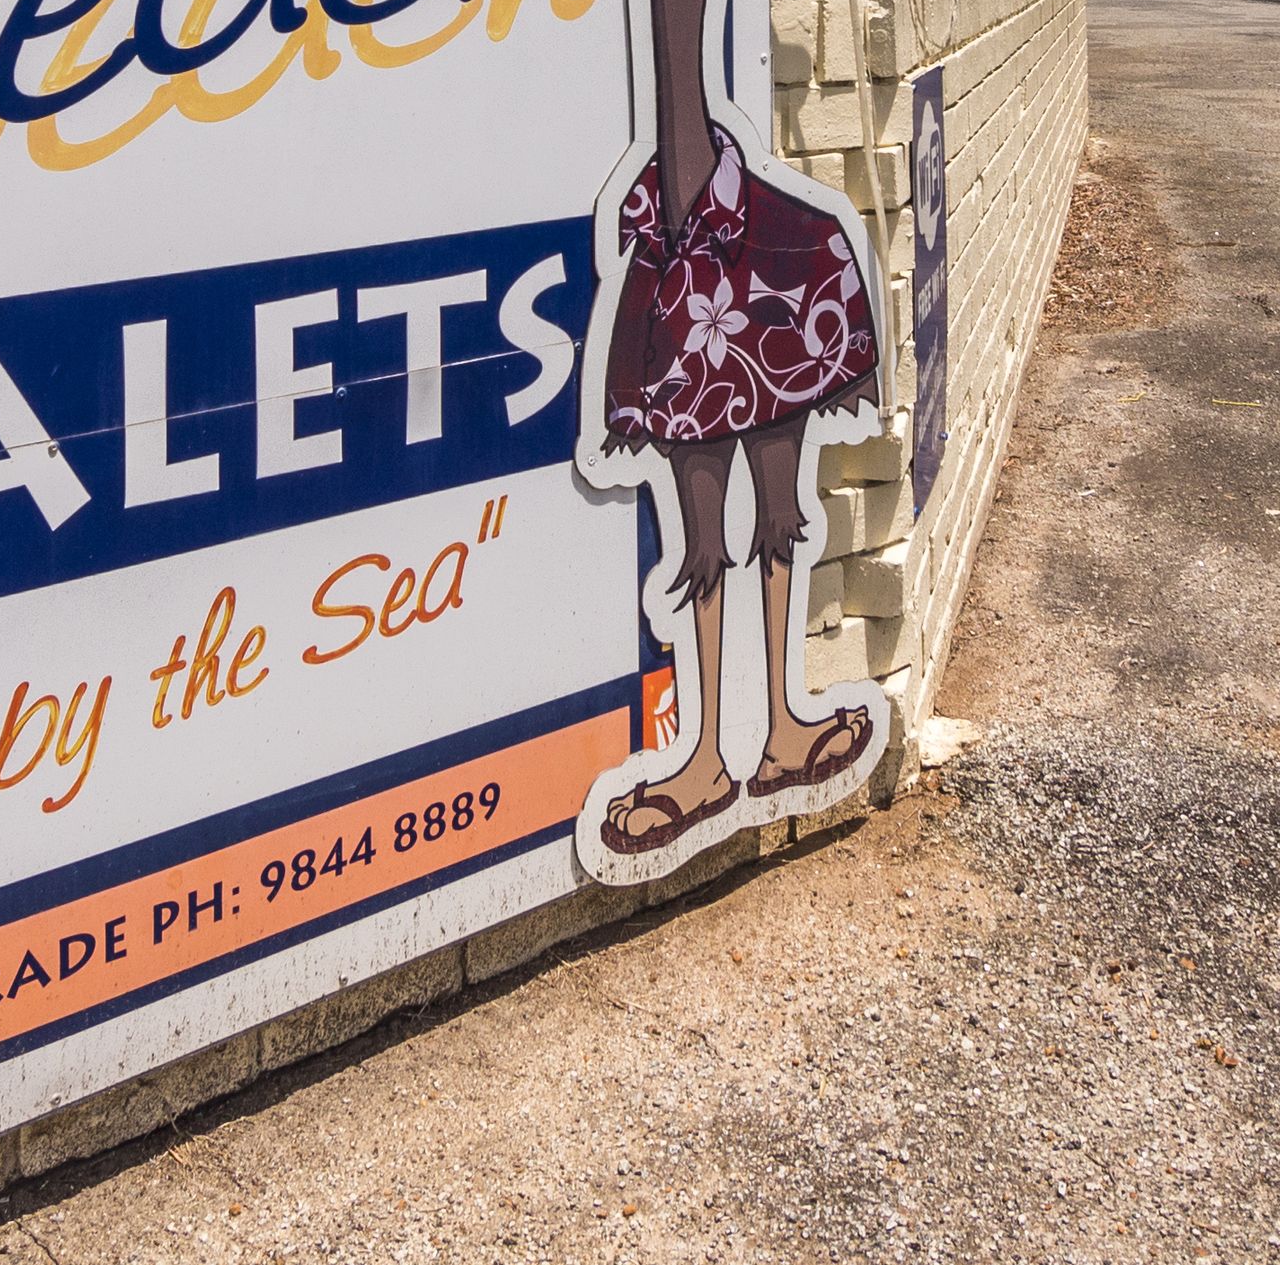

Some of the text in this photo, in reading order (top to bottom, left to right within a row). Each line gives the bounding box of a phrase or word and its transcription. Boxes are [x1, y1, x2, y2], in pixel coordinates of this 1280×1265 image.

[150, 586, 271, 730] the
[302, 494, 508, 666] Sea"
[152, 878, 243, 949] PH:
[257, 813, 380, 907] 9844
[392, 780, 505, 856] 8889
